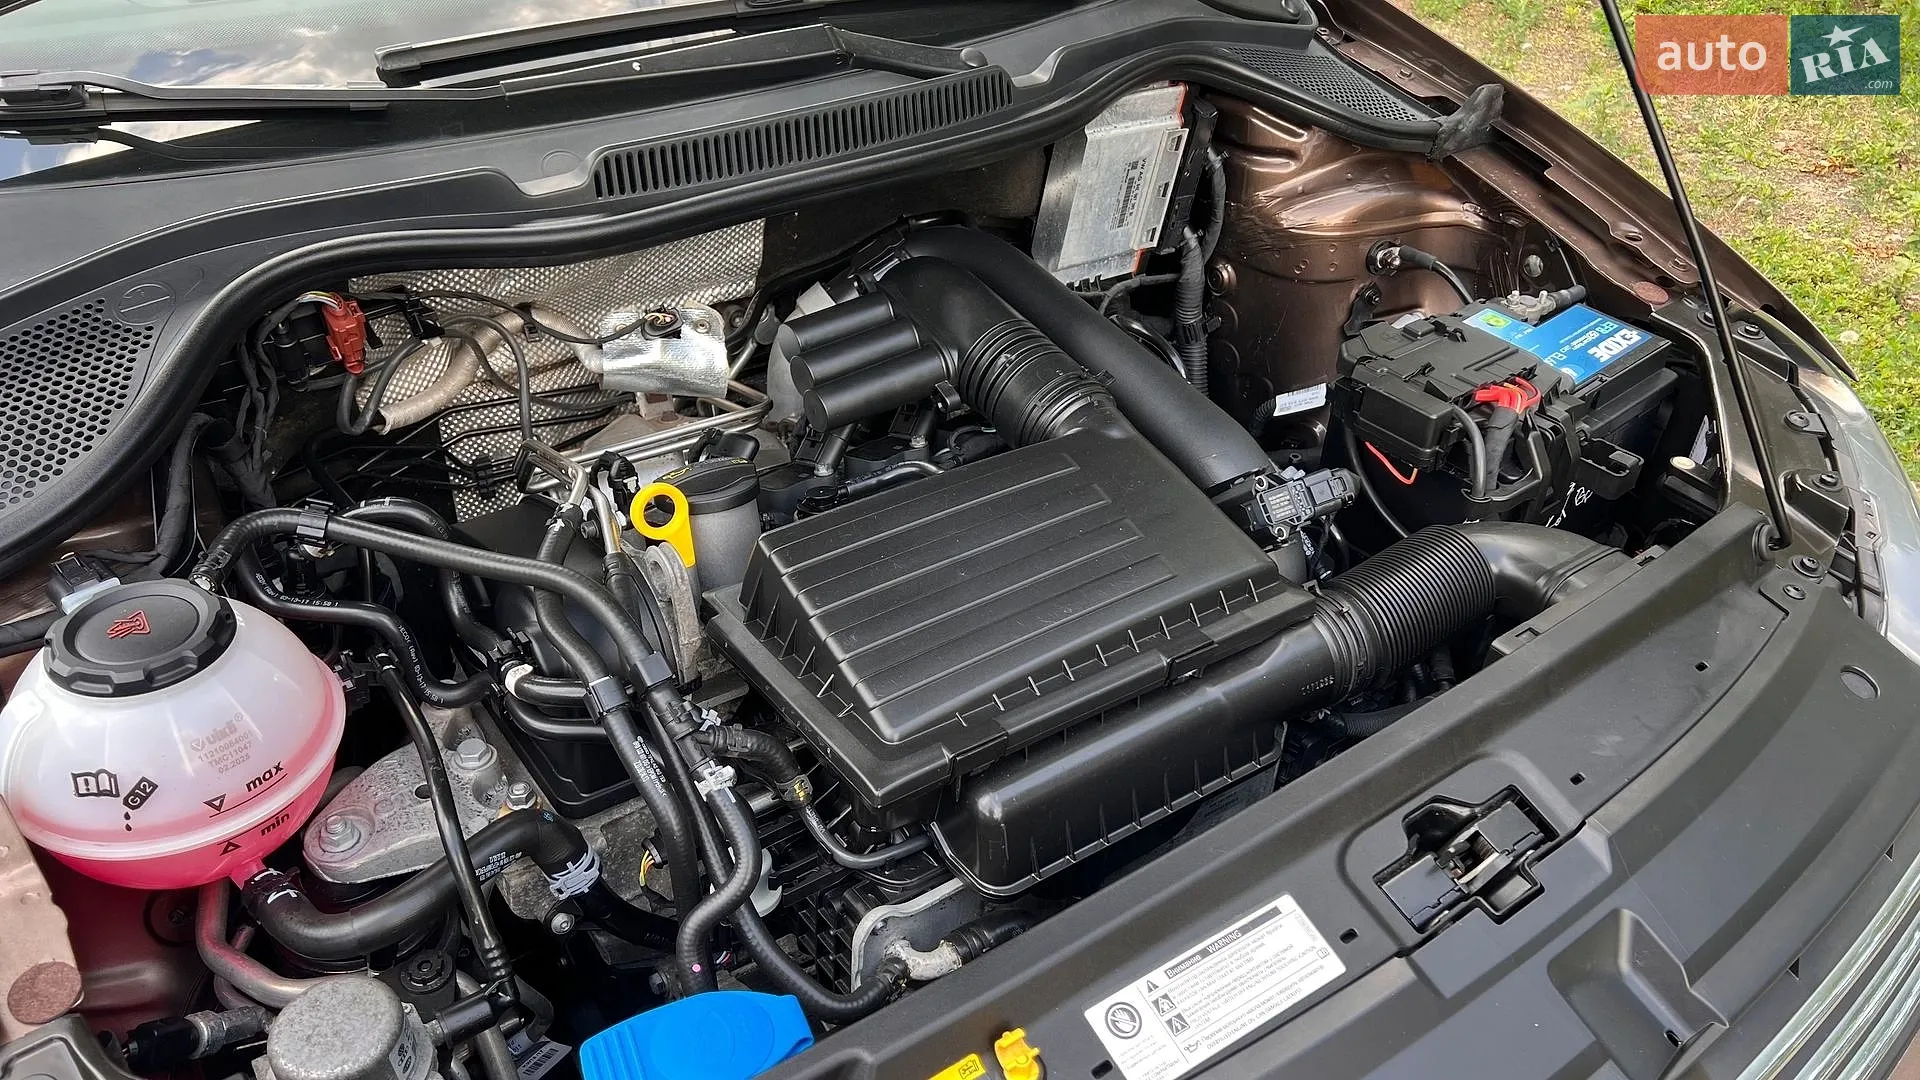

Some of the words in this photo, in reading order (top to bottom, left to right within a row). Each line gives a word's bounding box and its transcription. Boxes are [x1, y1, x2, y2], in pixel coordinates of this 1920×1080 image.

[1586, 328, 1642, 363] EXIDE
[245, 761, 284, 793] max
[127, 781, 152, 807] G12
[260, 812, 290, 837] min
[1206, 929, 1242, 954] WARNING
